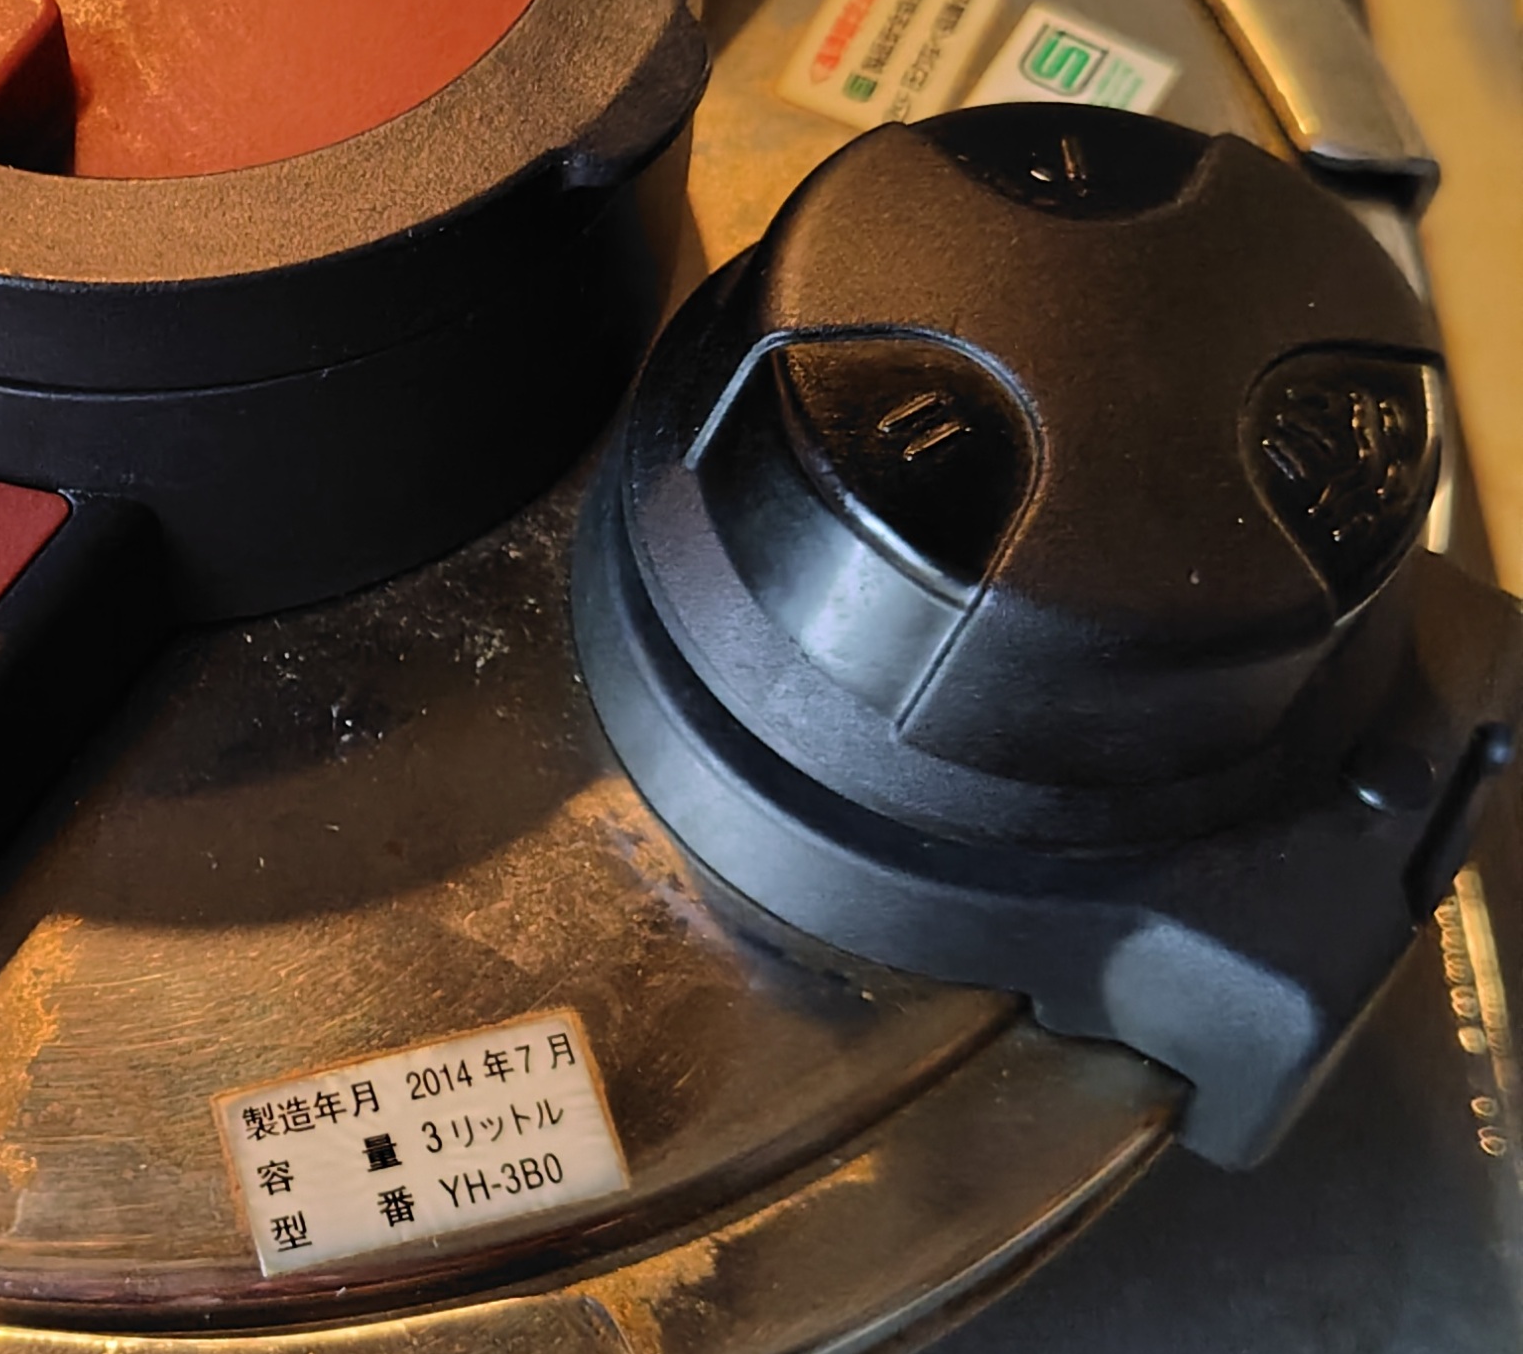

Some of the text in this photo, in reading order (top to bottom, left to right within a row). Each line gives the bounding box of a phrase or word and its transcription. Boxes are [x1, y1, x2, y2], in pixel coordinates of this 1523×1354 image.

[241, 1080, 381, 1142] 製造年月
[421, 1099, 564, 1154] 3リットル
[438, 1152, 564, 1208] YH-3B0
